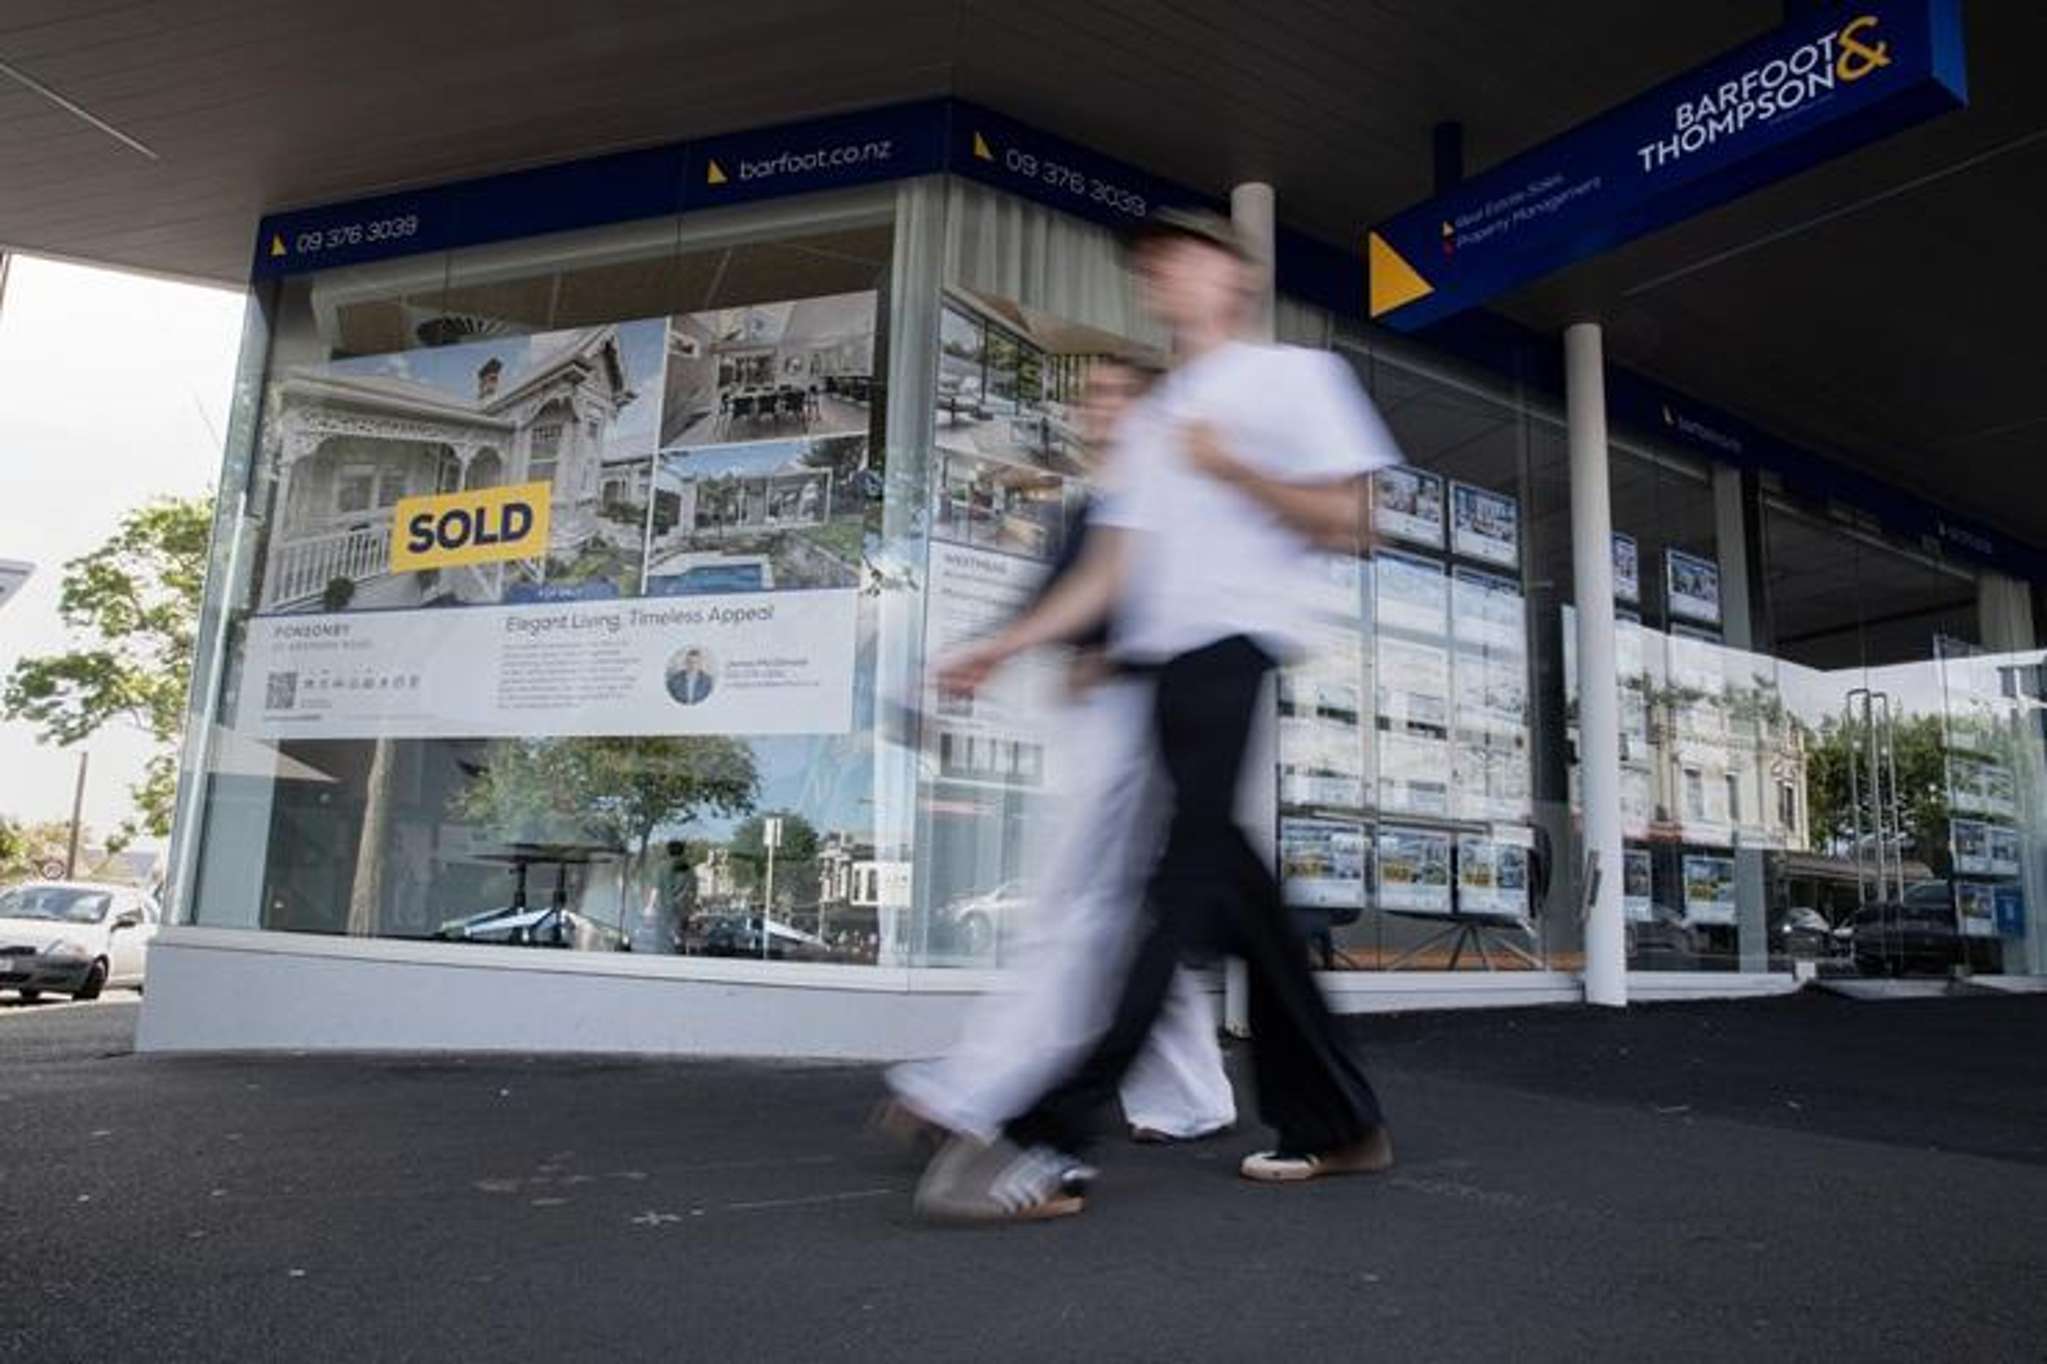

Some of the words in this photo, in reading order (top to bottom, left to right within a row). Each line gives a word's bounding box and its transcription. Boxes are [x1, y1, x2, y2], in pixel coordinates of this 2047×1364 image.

[1675, 31, 1838, 131] BARFOOT
[1836, 15, 1892, 81] &
[1637, 62, 1835, 172] THOMPSON
[740, 140, 892, 181] barfoot.co.nz
[1006, 149, 1038, 177] 09
[1042, 163, 1086, 194] 376
[1089, 179, 1147, 217] 3039
[408, 502, 533, 554] SOLD
[505, 614, 567, 636] Elegant
[629, 606, 704, 627] Timeless
[707, 604, 775, 624] Appeal
